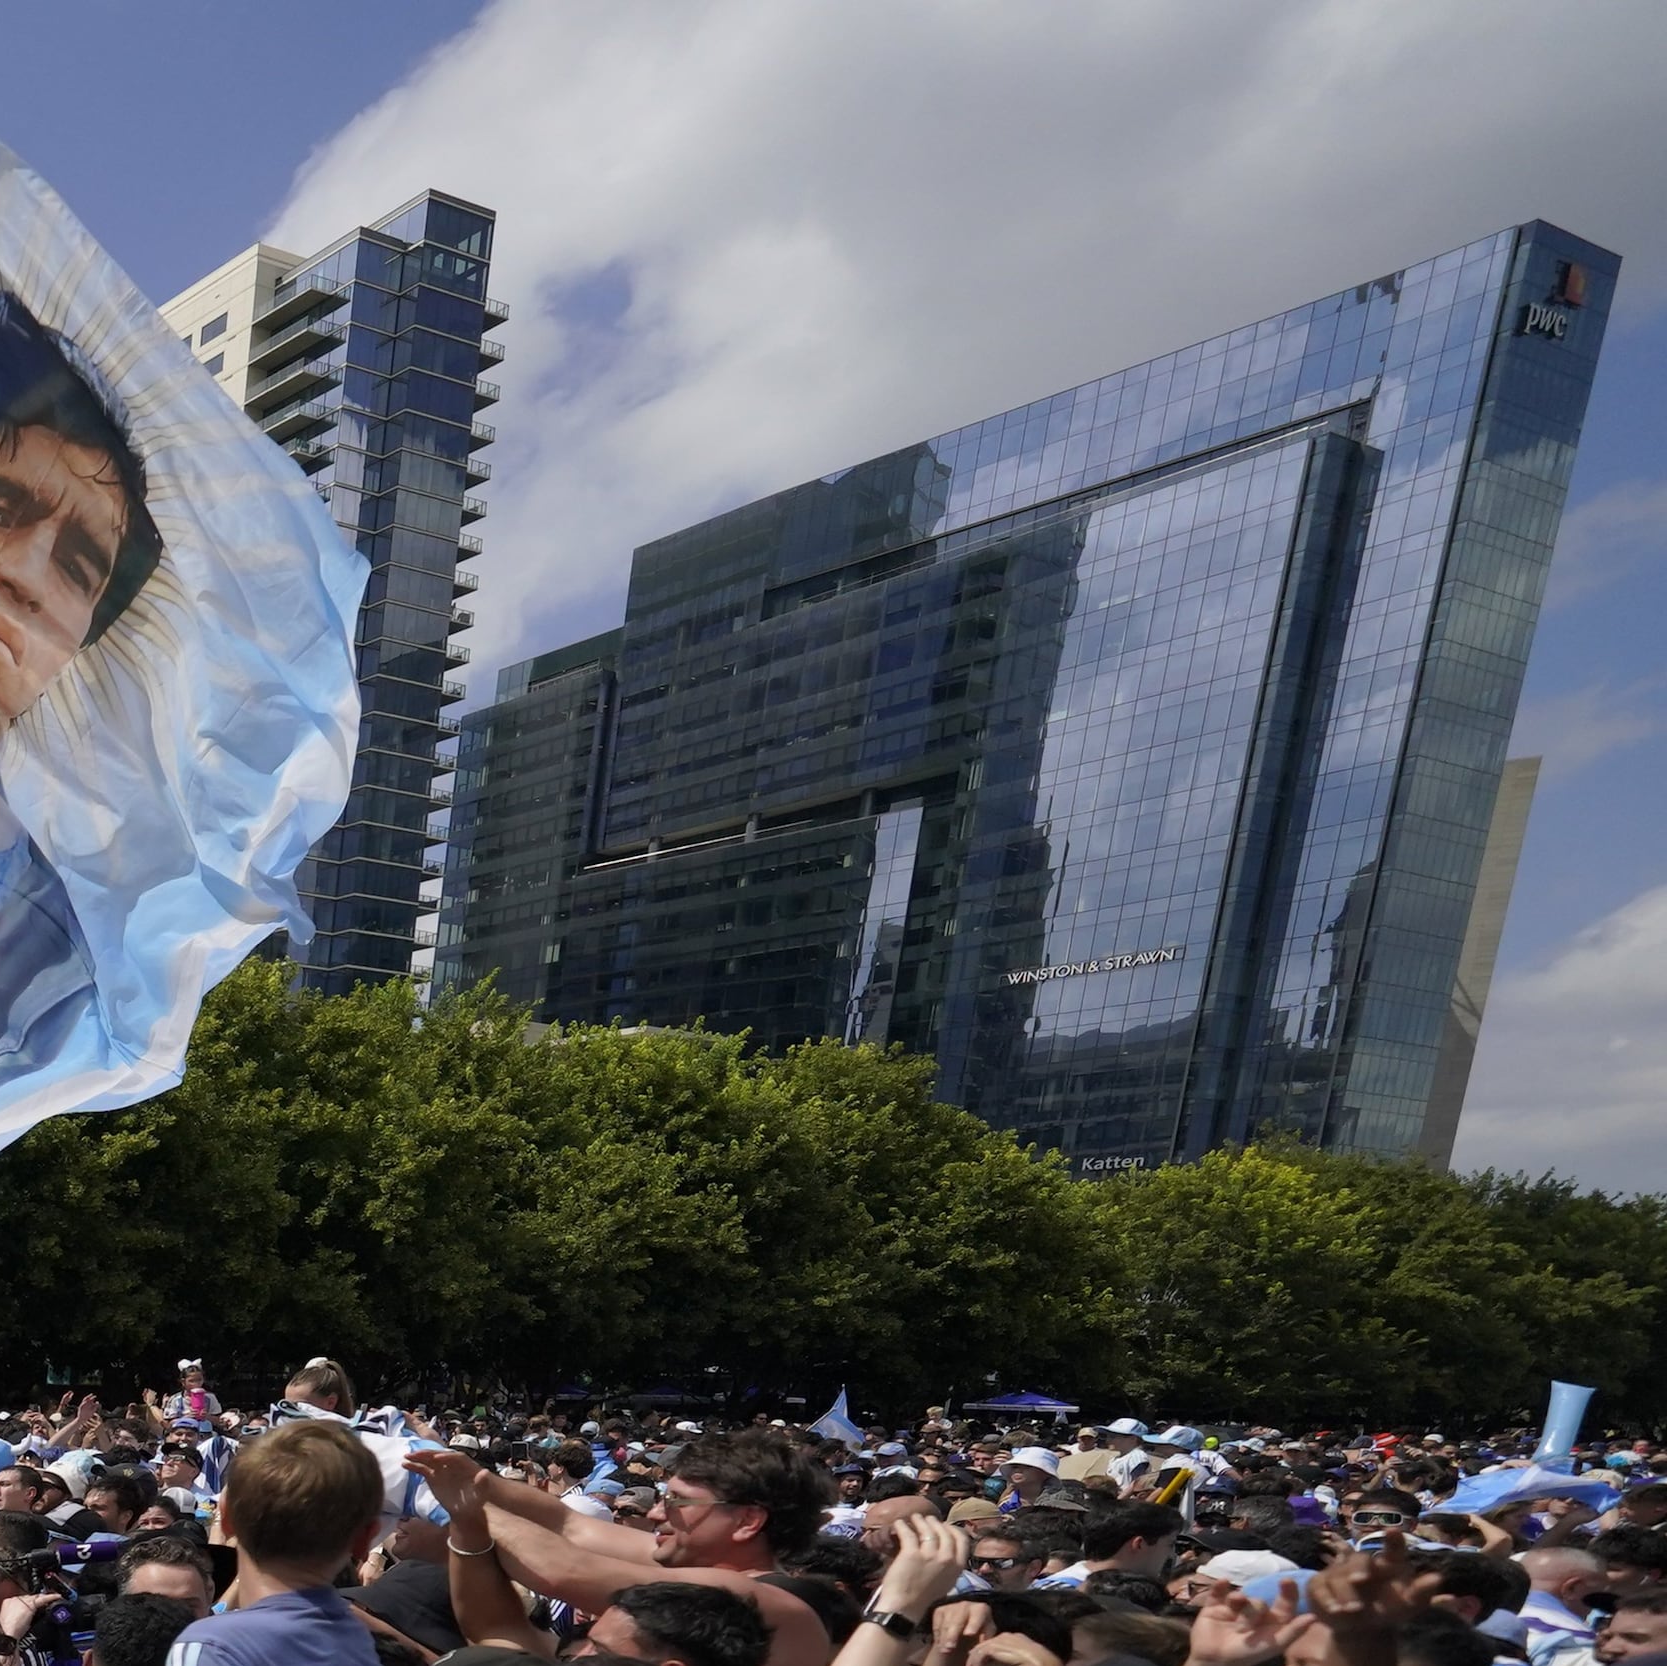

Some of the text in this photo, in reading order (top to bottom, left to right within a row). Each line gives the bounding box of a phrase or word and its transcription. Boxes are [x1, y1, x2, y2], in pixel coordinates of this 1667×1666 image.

[1524, 303, 1567, 337] pwc
[1007, 949, 1175, 985] WINSTON & STRAWN
